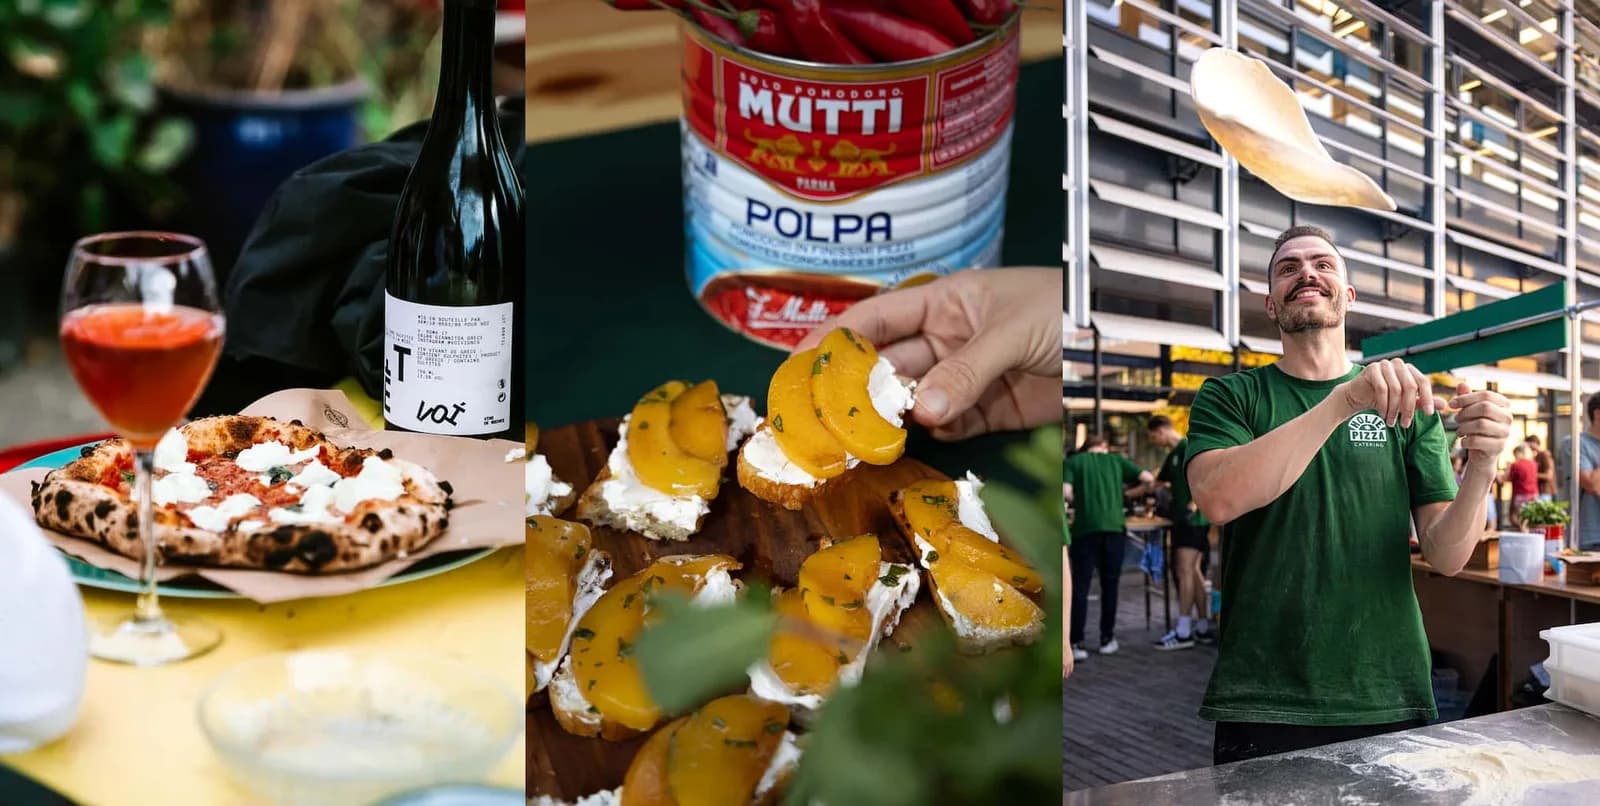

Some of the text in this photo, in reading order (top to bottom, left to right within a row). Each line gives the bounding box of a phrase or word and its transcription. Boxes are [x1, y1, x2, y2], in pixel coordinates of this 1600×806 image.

[739, 71, 782, 91] SOLO
[738, 81, 904, 136] MUTTI
[796, 177, 837, 192] PARMA
[746, 196, 893, 244] POLPA
[1350, 415, 1385, 429] HOLIE
[1352, 431, 1385, 440] PIZZA
